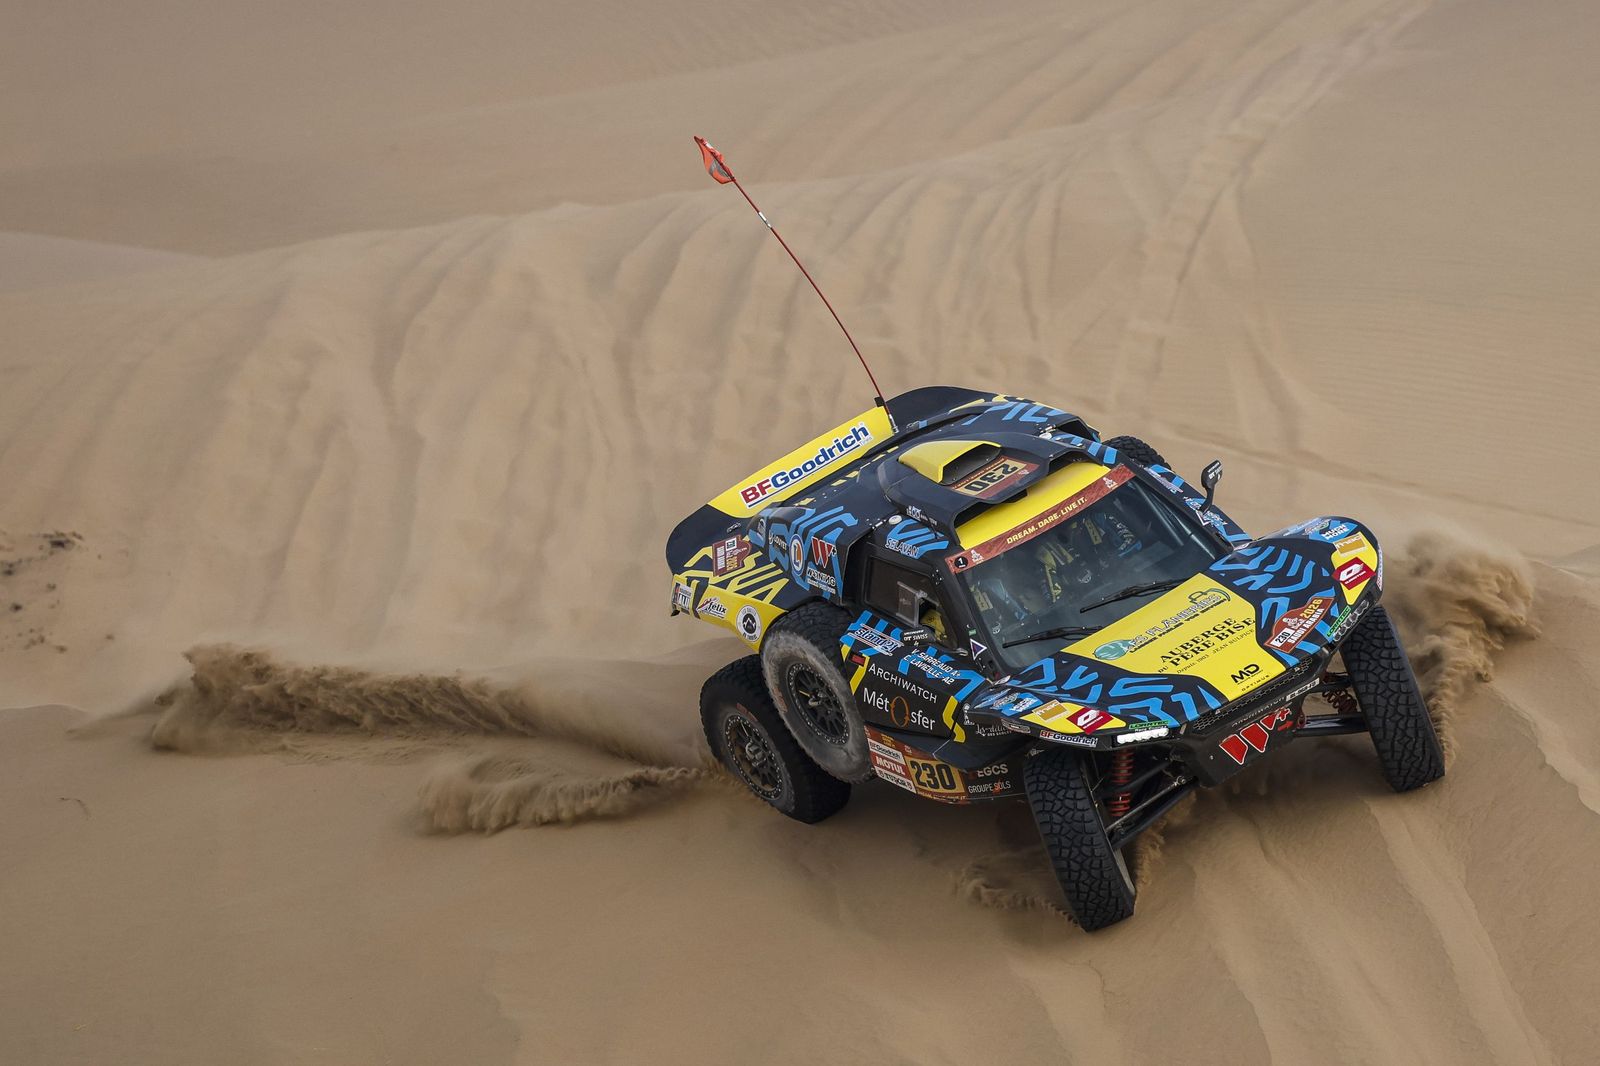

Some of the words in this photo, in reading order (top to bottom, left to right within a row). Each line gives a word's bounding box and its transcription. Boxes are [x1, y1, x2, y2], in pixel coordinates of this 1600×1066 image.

[740, 425, 869, 504] BFGoodrich
[963, 463, 1019, 492] 230
[1007, 525, 1038, 545] DREAM.
[1037, 513, 1061, 529] DARE.
[1060, 502, 1078, 515] LIVE
[1077, 496, 1088, 506] IT.
[1274, 631, 1291, 644] 230
[1299, 598, 1324, 619] 2026
[1287, 626, 1308, 644] SAUDI
[1303, 608, 1325, 631] ARABIA
[1158, 665, 1169, 674] DU
[1215, 617, 1256, 642] BISE
[1160, 617, 1237, 663] AUBERGE
[910, 658, 942, 679] LAVIEILLE
[919, 652, 953, 673] SARREAUD
[1230, 663, 1260, 684] MD
[868, 663, 938, 704] ARCHIWATCH
[1040, 729, 1099, 746] BFGoodrich
[875, 755, 906, 775] MOTUL
[909, 760, 957, 791] 230
[967, 783, 994, 794] GROUPE
[993, 781, 1011, 792] SOLS
